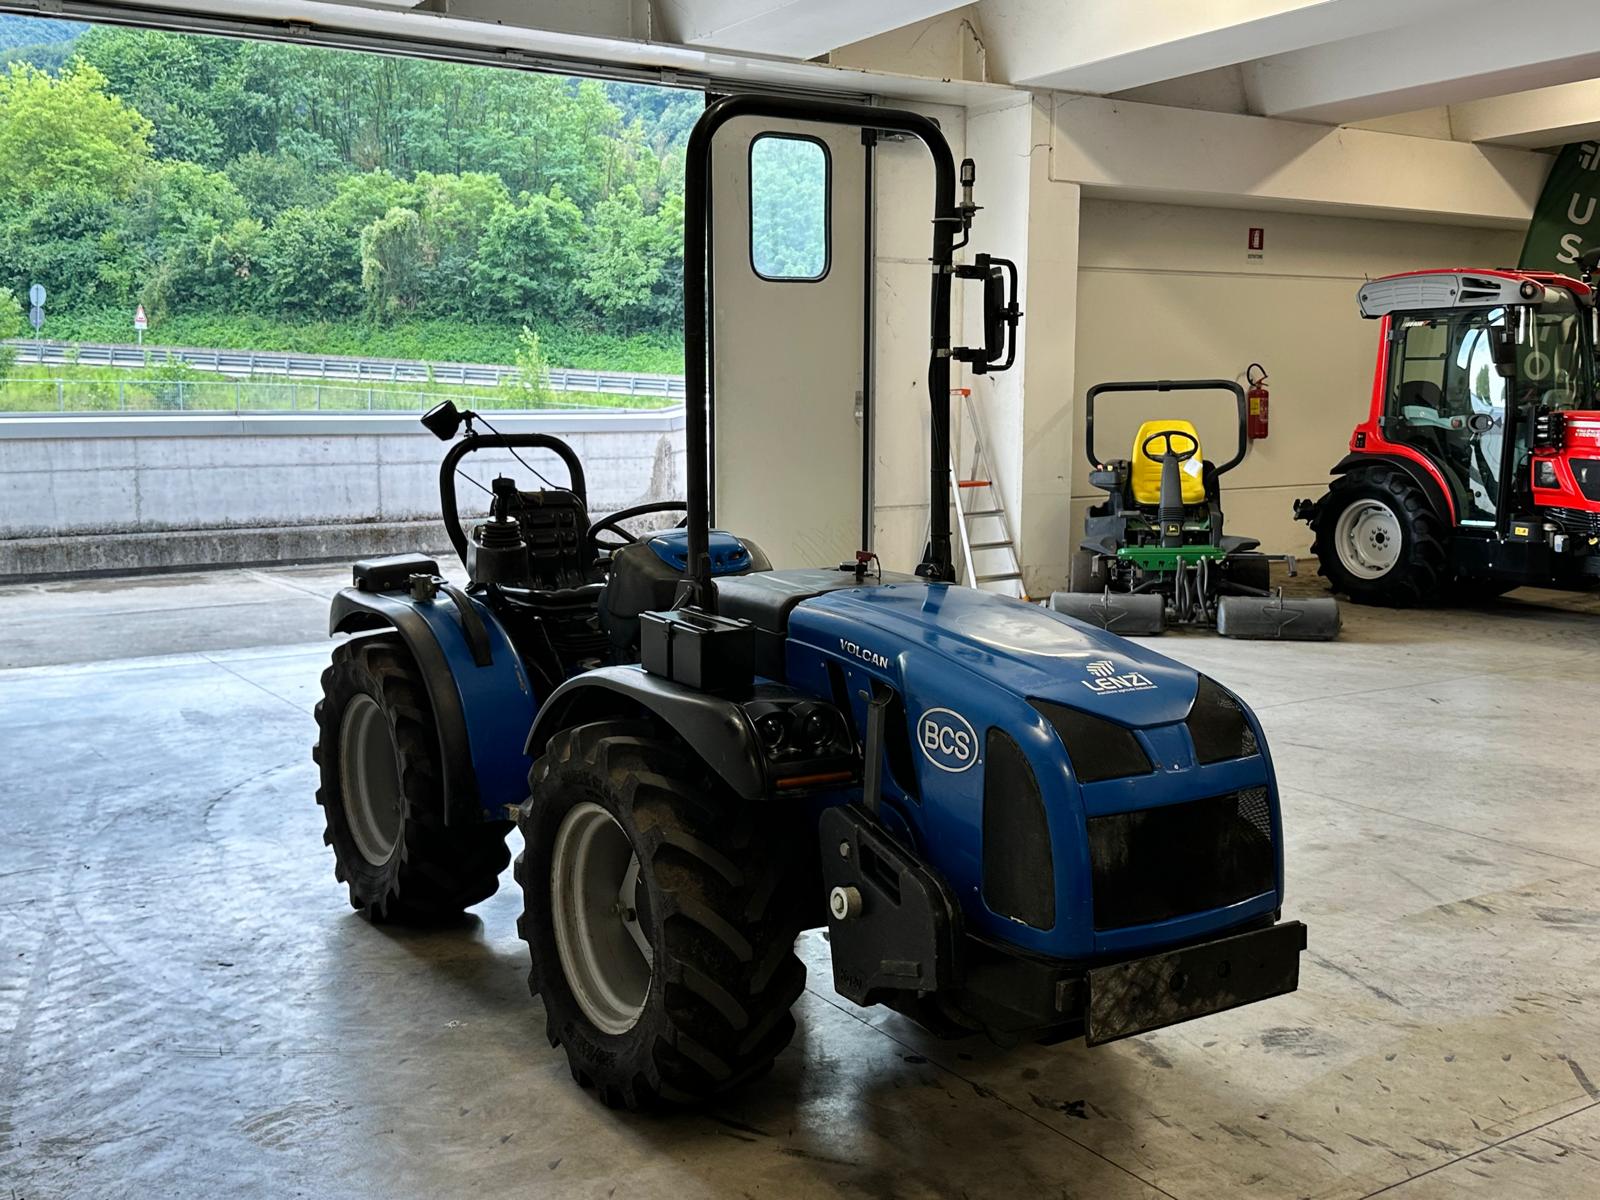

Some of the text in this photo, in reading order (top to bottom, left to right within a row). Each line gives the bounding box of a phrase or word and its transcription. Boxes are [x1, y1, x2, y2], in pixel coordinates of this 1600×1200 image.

[840, 638, 889, 669] VOLCAN
[1081, 672, 1154, 692] LENZI
[924, 720, 970, 760] BCS
